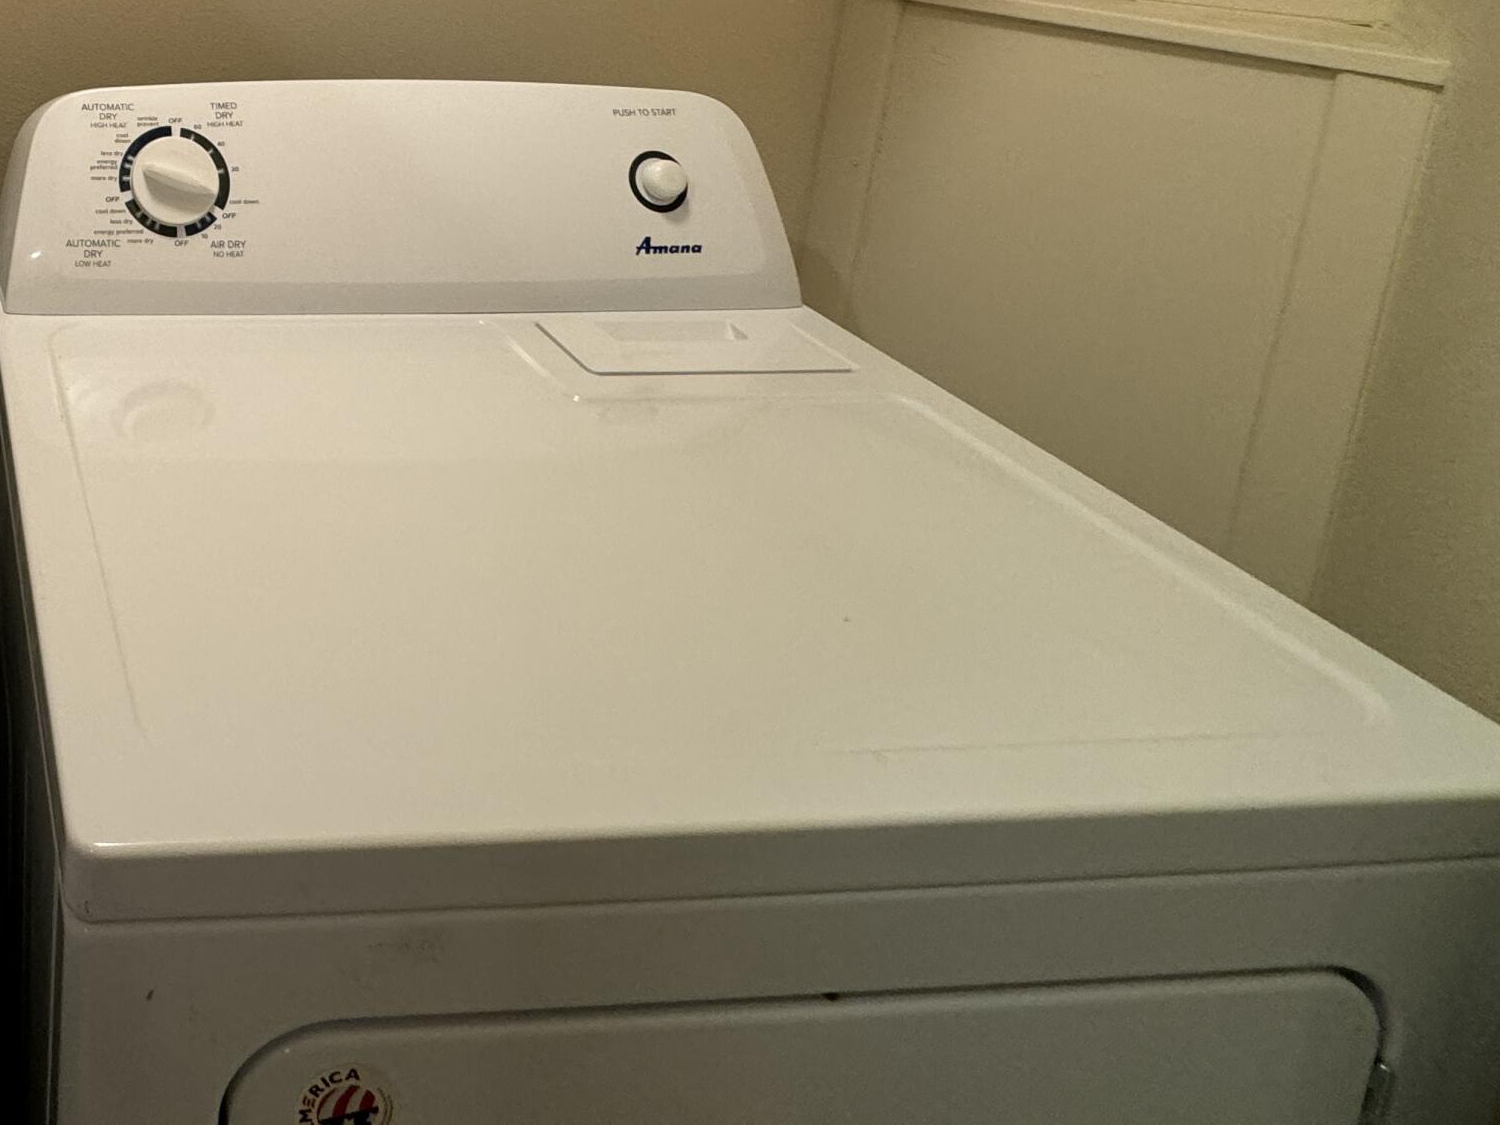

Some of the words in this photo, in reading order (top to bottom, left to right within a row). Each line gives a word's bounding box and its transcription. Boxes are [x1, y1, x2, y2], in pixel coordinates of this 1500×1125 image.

[81, 103, 134, 111] AUTOMATIC
[210, 102, 237, 110] TIMED
[651, 108, 676, 116] START
[65, 238, 121, 248] AUTOMATIC
[174, 239, 189, 247] OFF
[210, 240, 226, 248] AIR
[227, 240, 246, 248] DRY
[635, 236, 702, 256] Amana
[83, 249, 104, 259] DRY
[299, 1068, 360, 1125] MERICA
